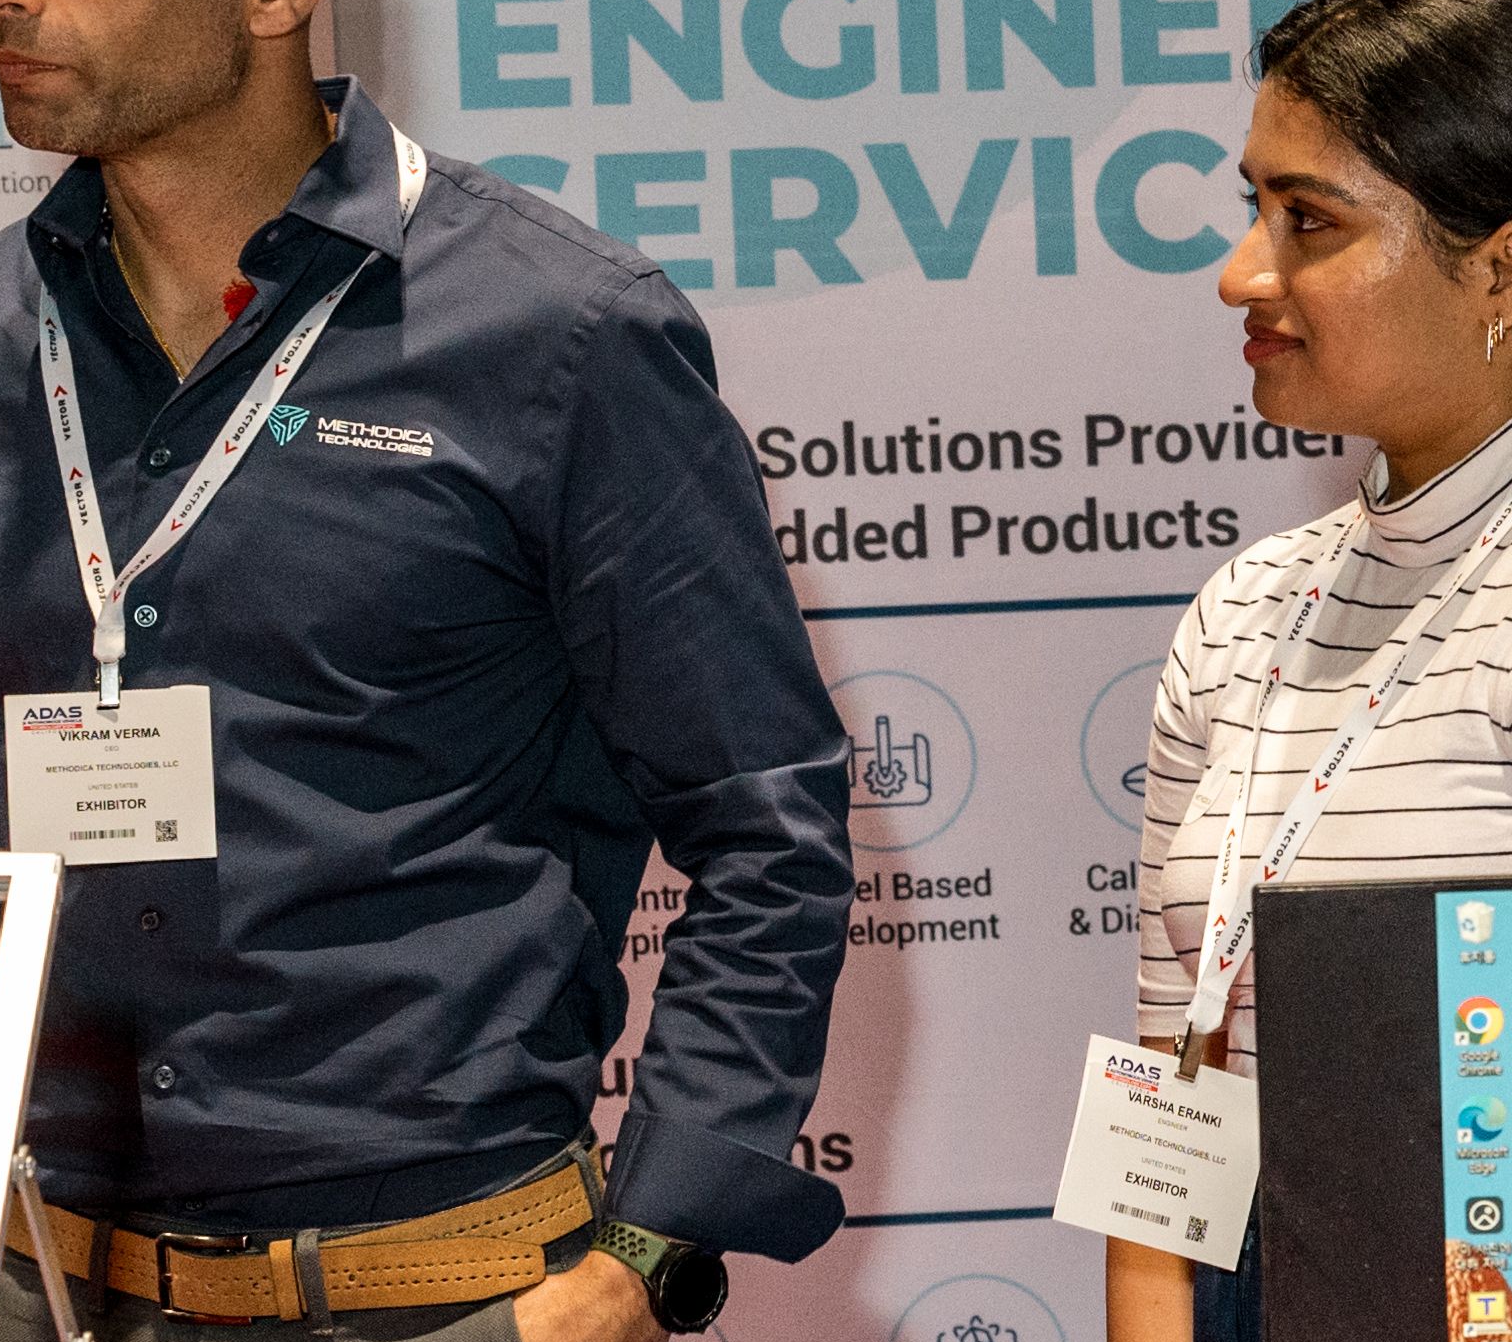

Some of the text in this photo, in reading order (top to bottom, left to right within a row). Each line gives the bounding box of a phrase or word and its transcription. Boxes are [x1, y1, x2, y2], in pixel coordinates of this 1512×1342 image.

[480, 126, 1260, 291] ERVIC
[283, 326, 312, 366] VECTOR
[59, 399, 71, 441] VECTOR
[233, 402, 262, 442] VECTOR
[318, 417, 434, 446] METHODICA
[316, 432, 433, 457] TECHNOLOGIES
[756, 417, 1064, 480] Solutions
[74, 481, 88, 526] VECTOR
[179, 480, 210, 519] VECTOR
[951, 497, 1241, 558] Products
[1329, 523, 1355, 563] VECTOR
[1288, 601, 1314, 642] VECTOR
[1376, 654, 1407, 696] VECTOR
[23, 706, 82, 719] ADAS
[60, 728, 160, 741] VIKRAM VERMA
[46, 764, 93, 773] METHODICA
[96, 762, 161, 772] TECHNOLOGIES,
[1323, 736, 1355, 779] VECTOR
[76, 799, 146, 811] EXHIBITOR
[1271, 821, 1301, 866] VECTOR
[1221, 842, 1234, 886] VECTOR
[891, 868, 992, 901] Based
[1070, 908, 1090, 935] &
[1106, 1055, 1162, 1080] ADAS
[1128, 1090, 1222, 1128] VARSHA ERANKI
[1109, 1124, 1227, 1165] METHODICA TECHNOLOGIES, LLC
[1125, 1171, 1188, 1199] EXHIBITOR
[1141, 1156, 1186, 1175] UNITED STATES
